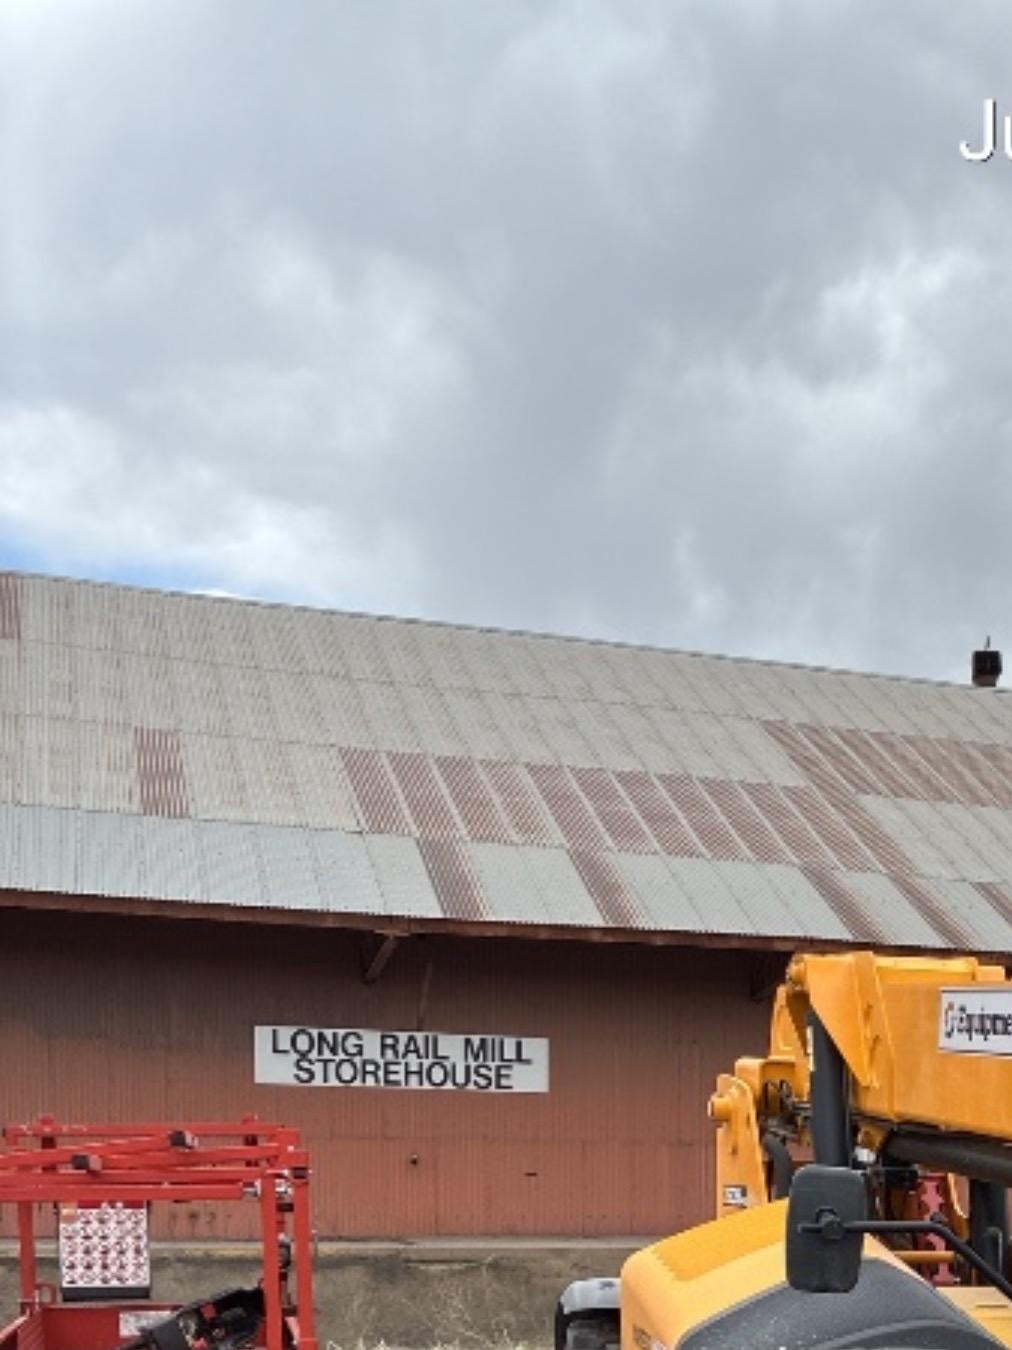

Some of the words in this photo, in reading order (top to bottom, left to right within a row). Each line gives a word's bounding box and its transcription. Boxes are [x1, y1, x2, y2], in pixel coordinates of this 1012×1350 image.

[271, 1028, 364, 1058] LONG
[380, 1034, 450, 1060] RAIL
[463, 1037, 533, 1065] MILL
[293, 1057, 514, 1090] STOREHOUSE
